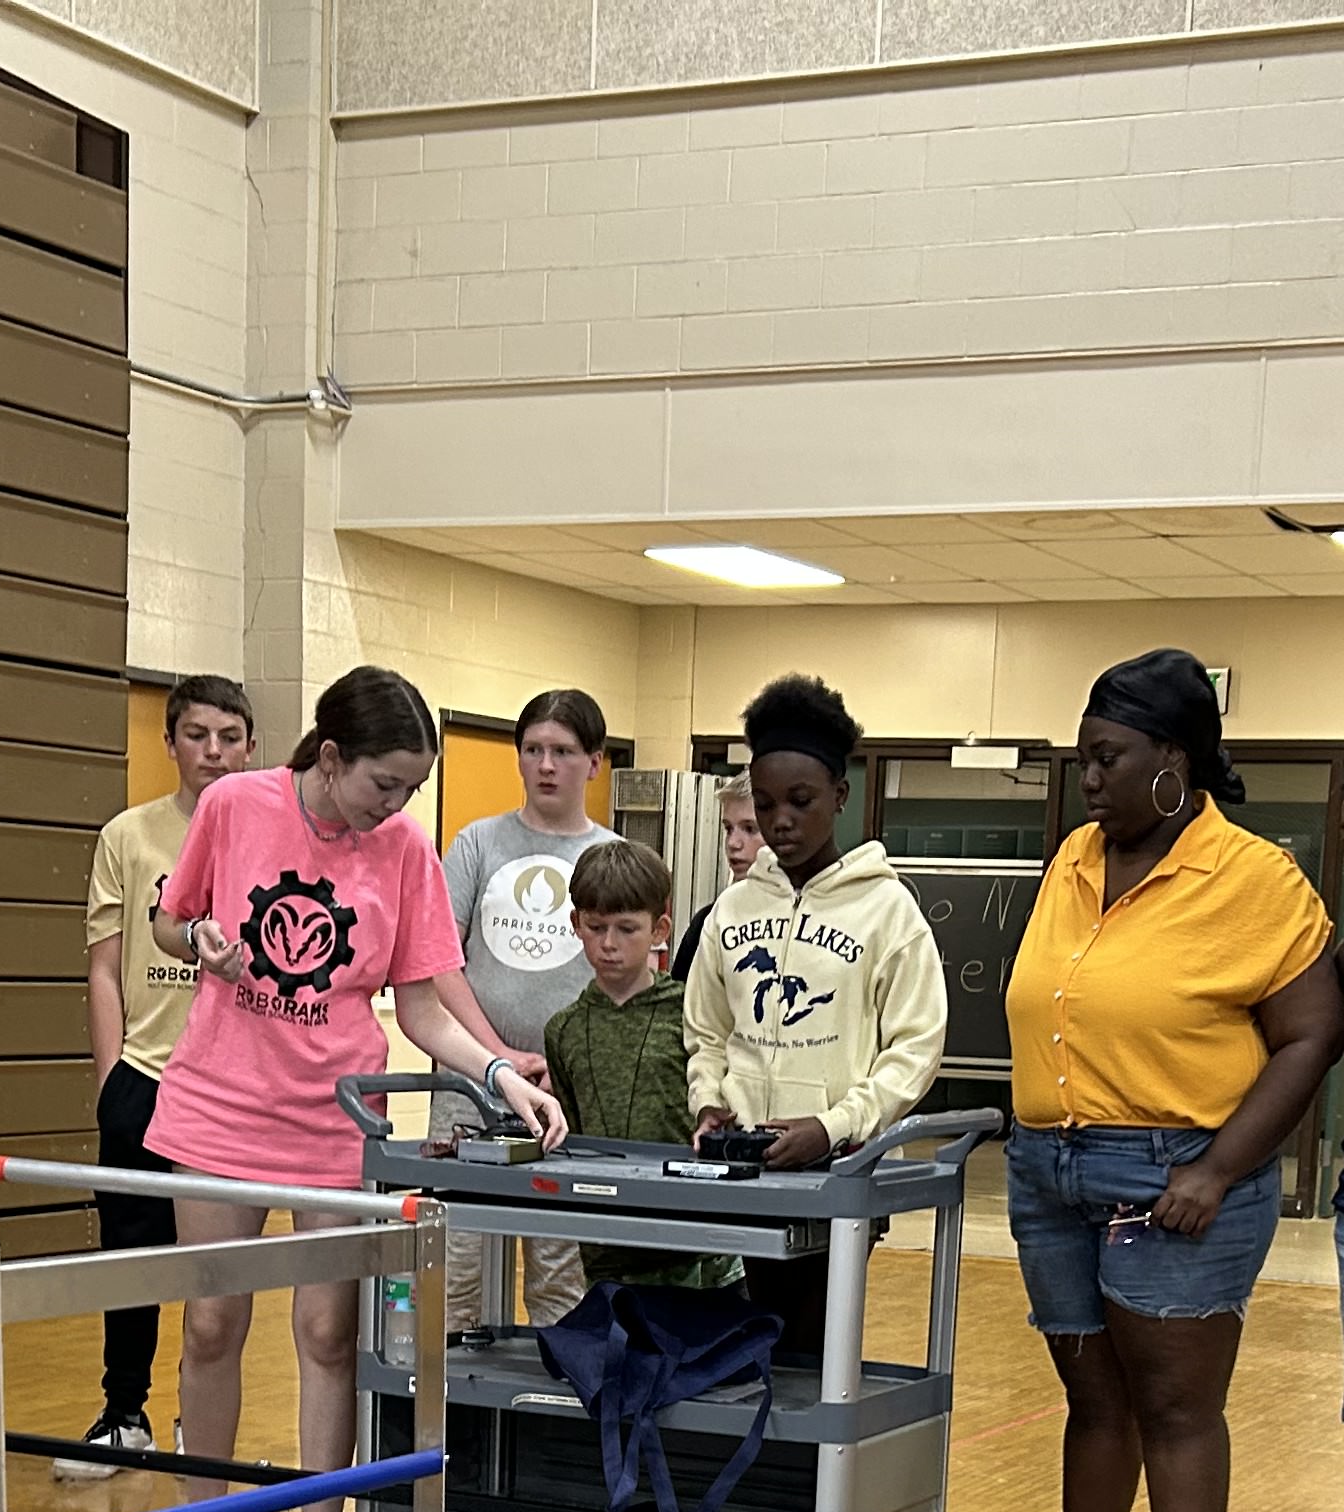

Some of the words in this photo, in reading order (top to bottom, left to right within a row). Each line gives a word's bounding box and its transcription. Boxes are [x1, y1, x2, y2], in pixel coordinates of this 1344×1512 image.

[492, 917, 533, 931] PARIS
[537, 923, 576, 938] 2024
[721, 918, 790, 951] GREAT
[794, 914, 864, 964] LAKES
[236, 983, 329, 1018] ROBORAMS
